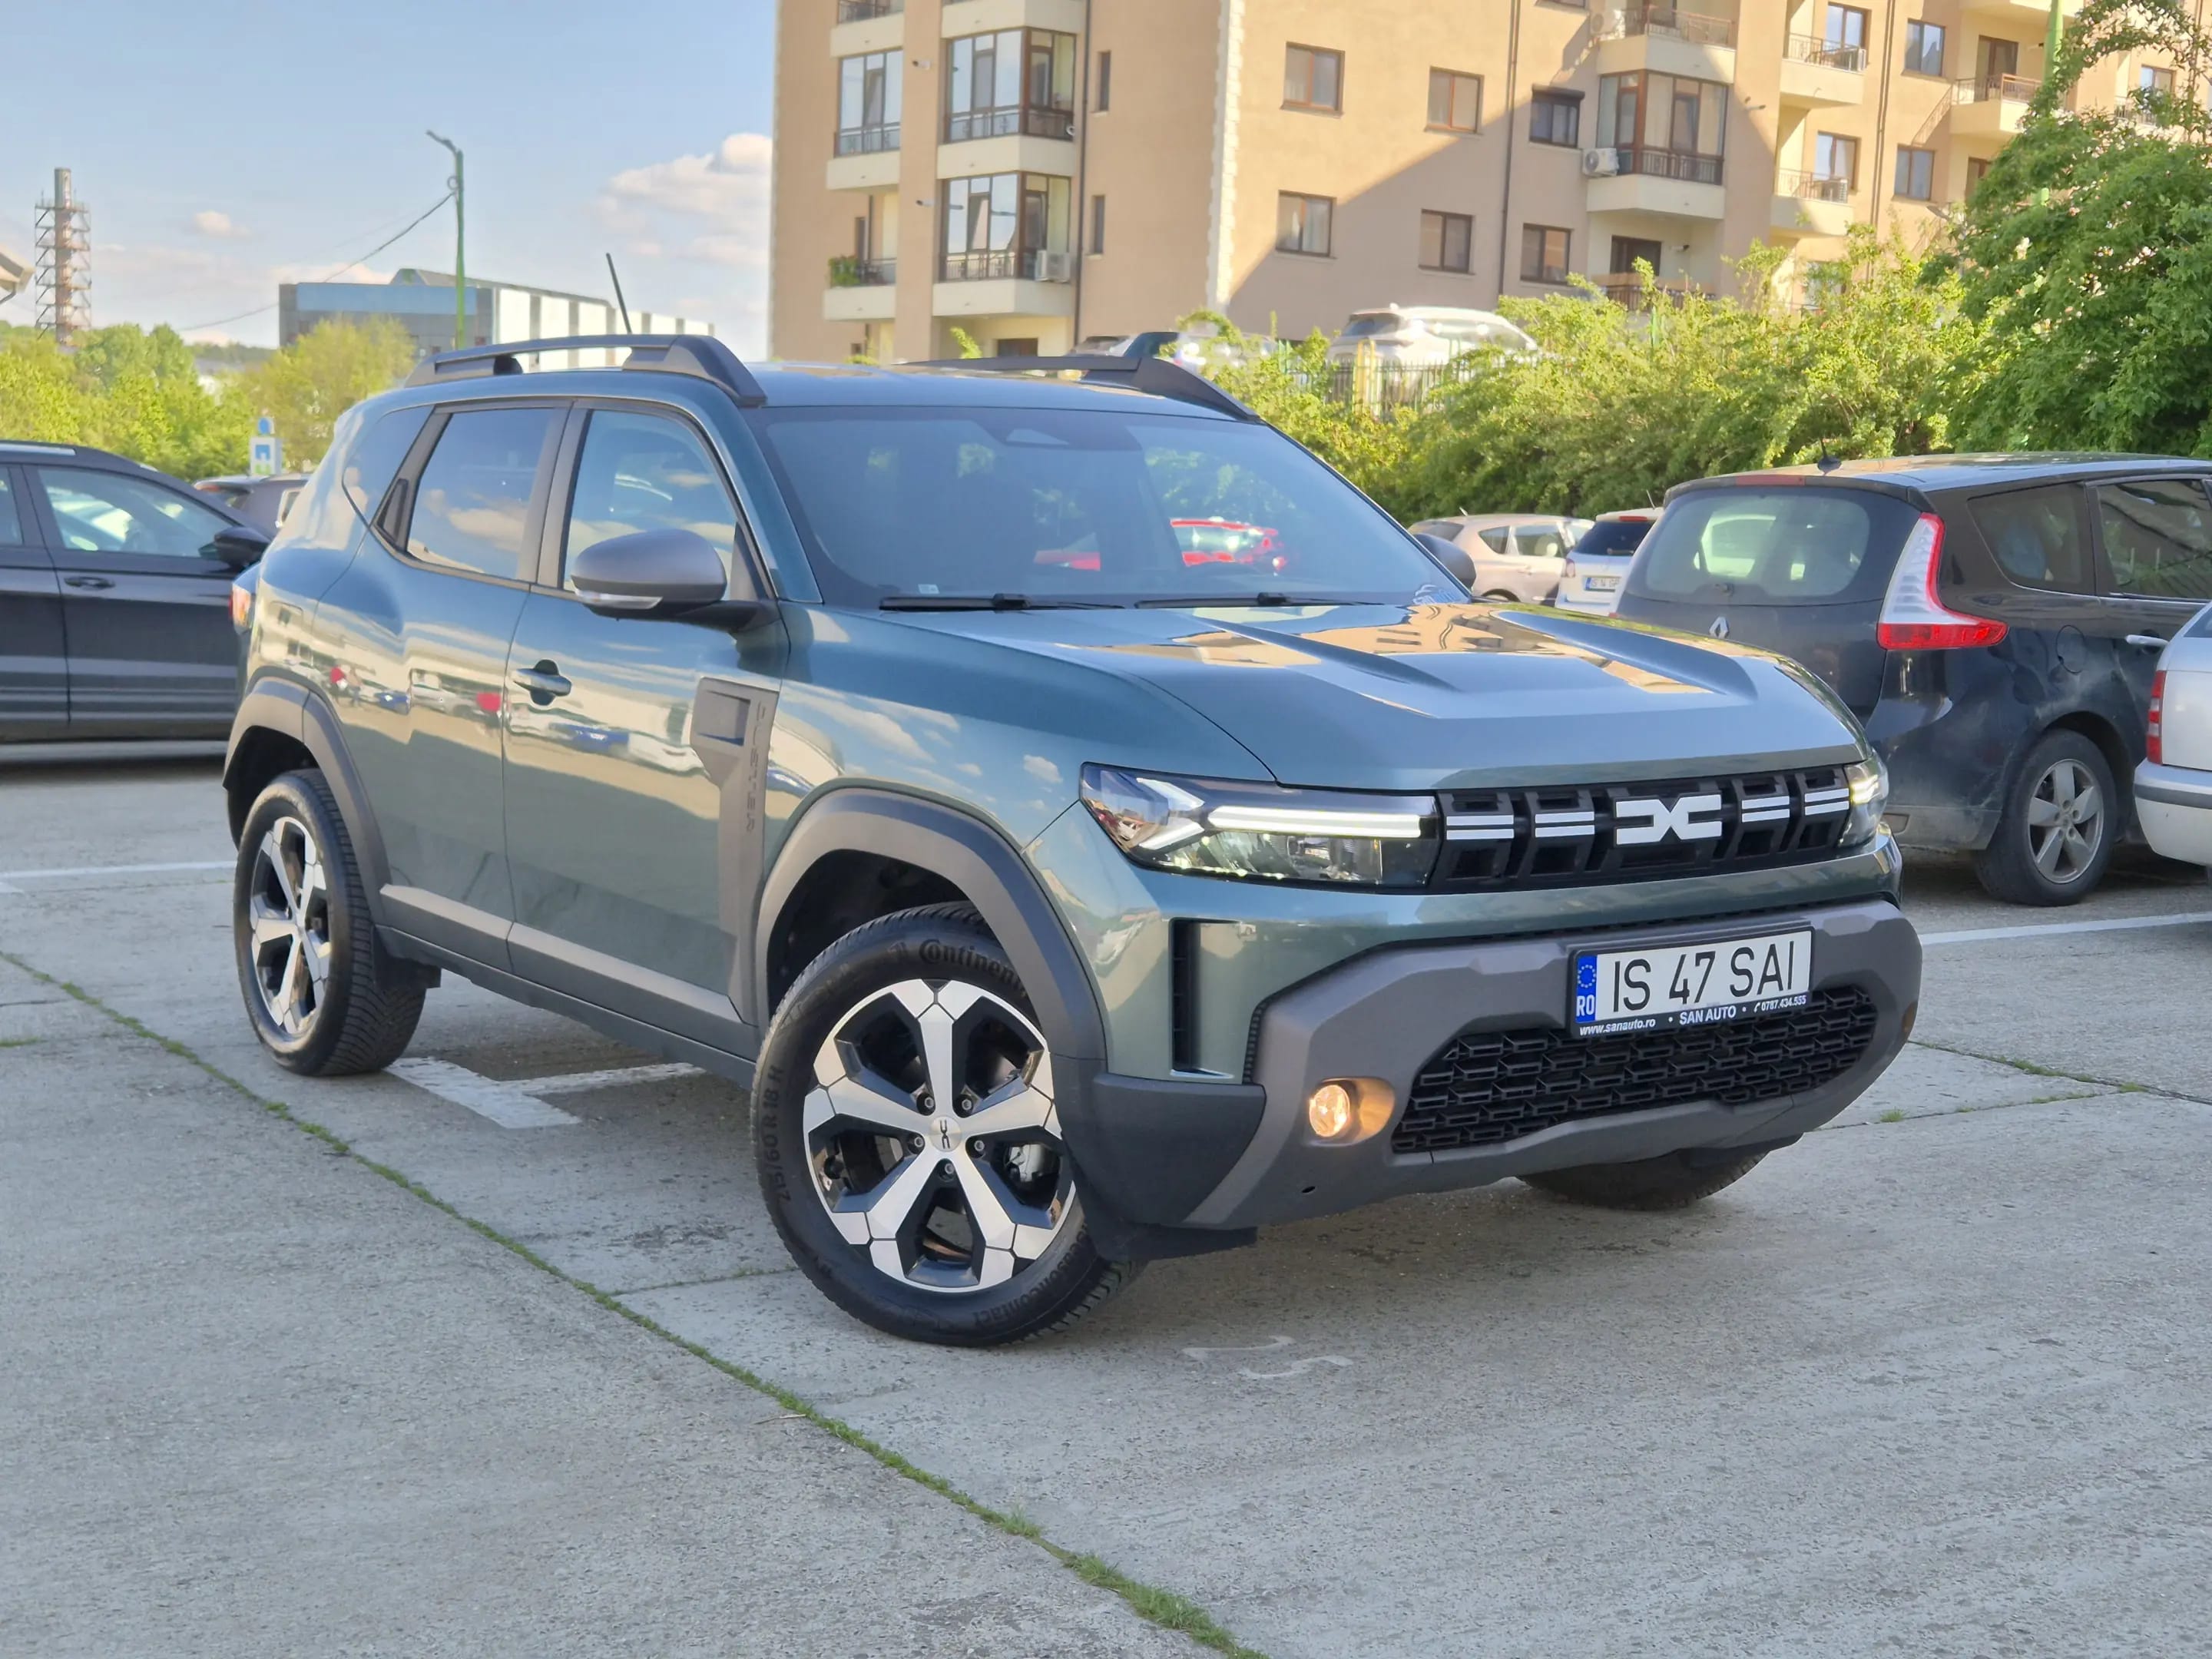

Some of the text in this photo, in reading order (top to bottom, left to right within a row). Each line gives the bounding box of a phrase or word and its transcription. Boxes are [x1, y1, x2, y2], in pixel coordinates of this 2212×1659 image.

[746, 700, 767, 833] DUSTER
[1614, 940, 1795, 1013] IS 47 SAI
[1576, 995, 1596, 1017] RO
[1579, 1018, 1656, 1036] www.sanauto.ro
[1679, 1009, 1704, 1025] SAN
[1705, 1005, 1737, 1022] AUTO
